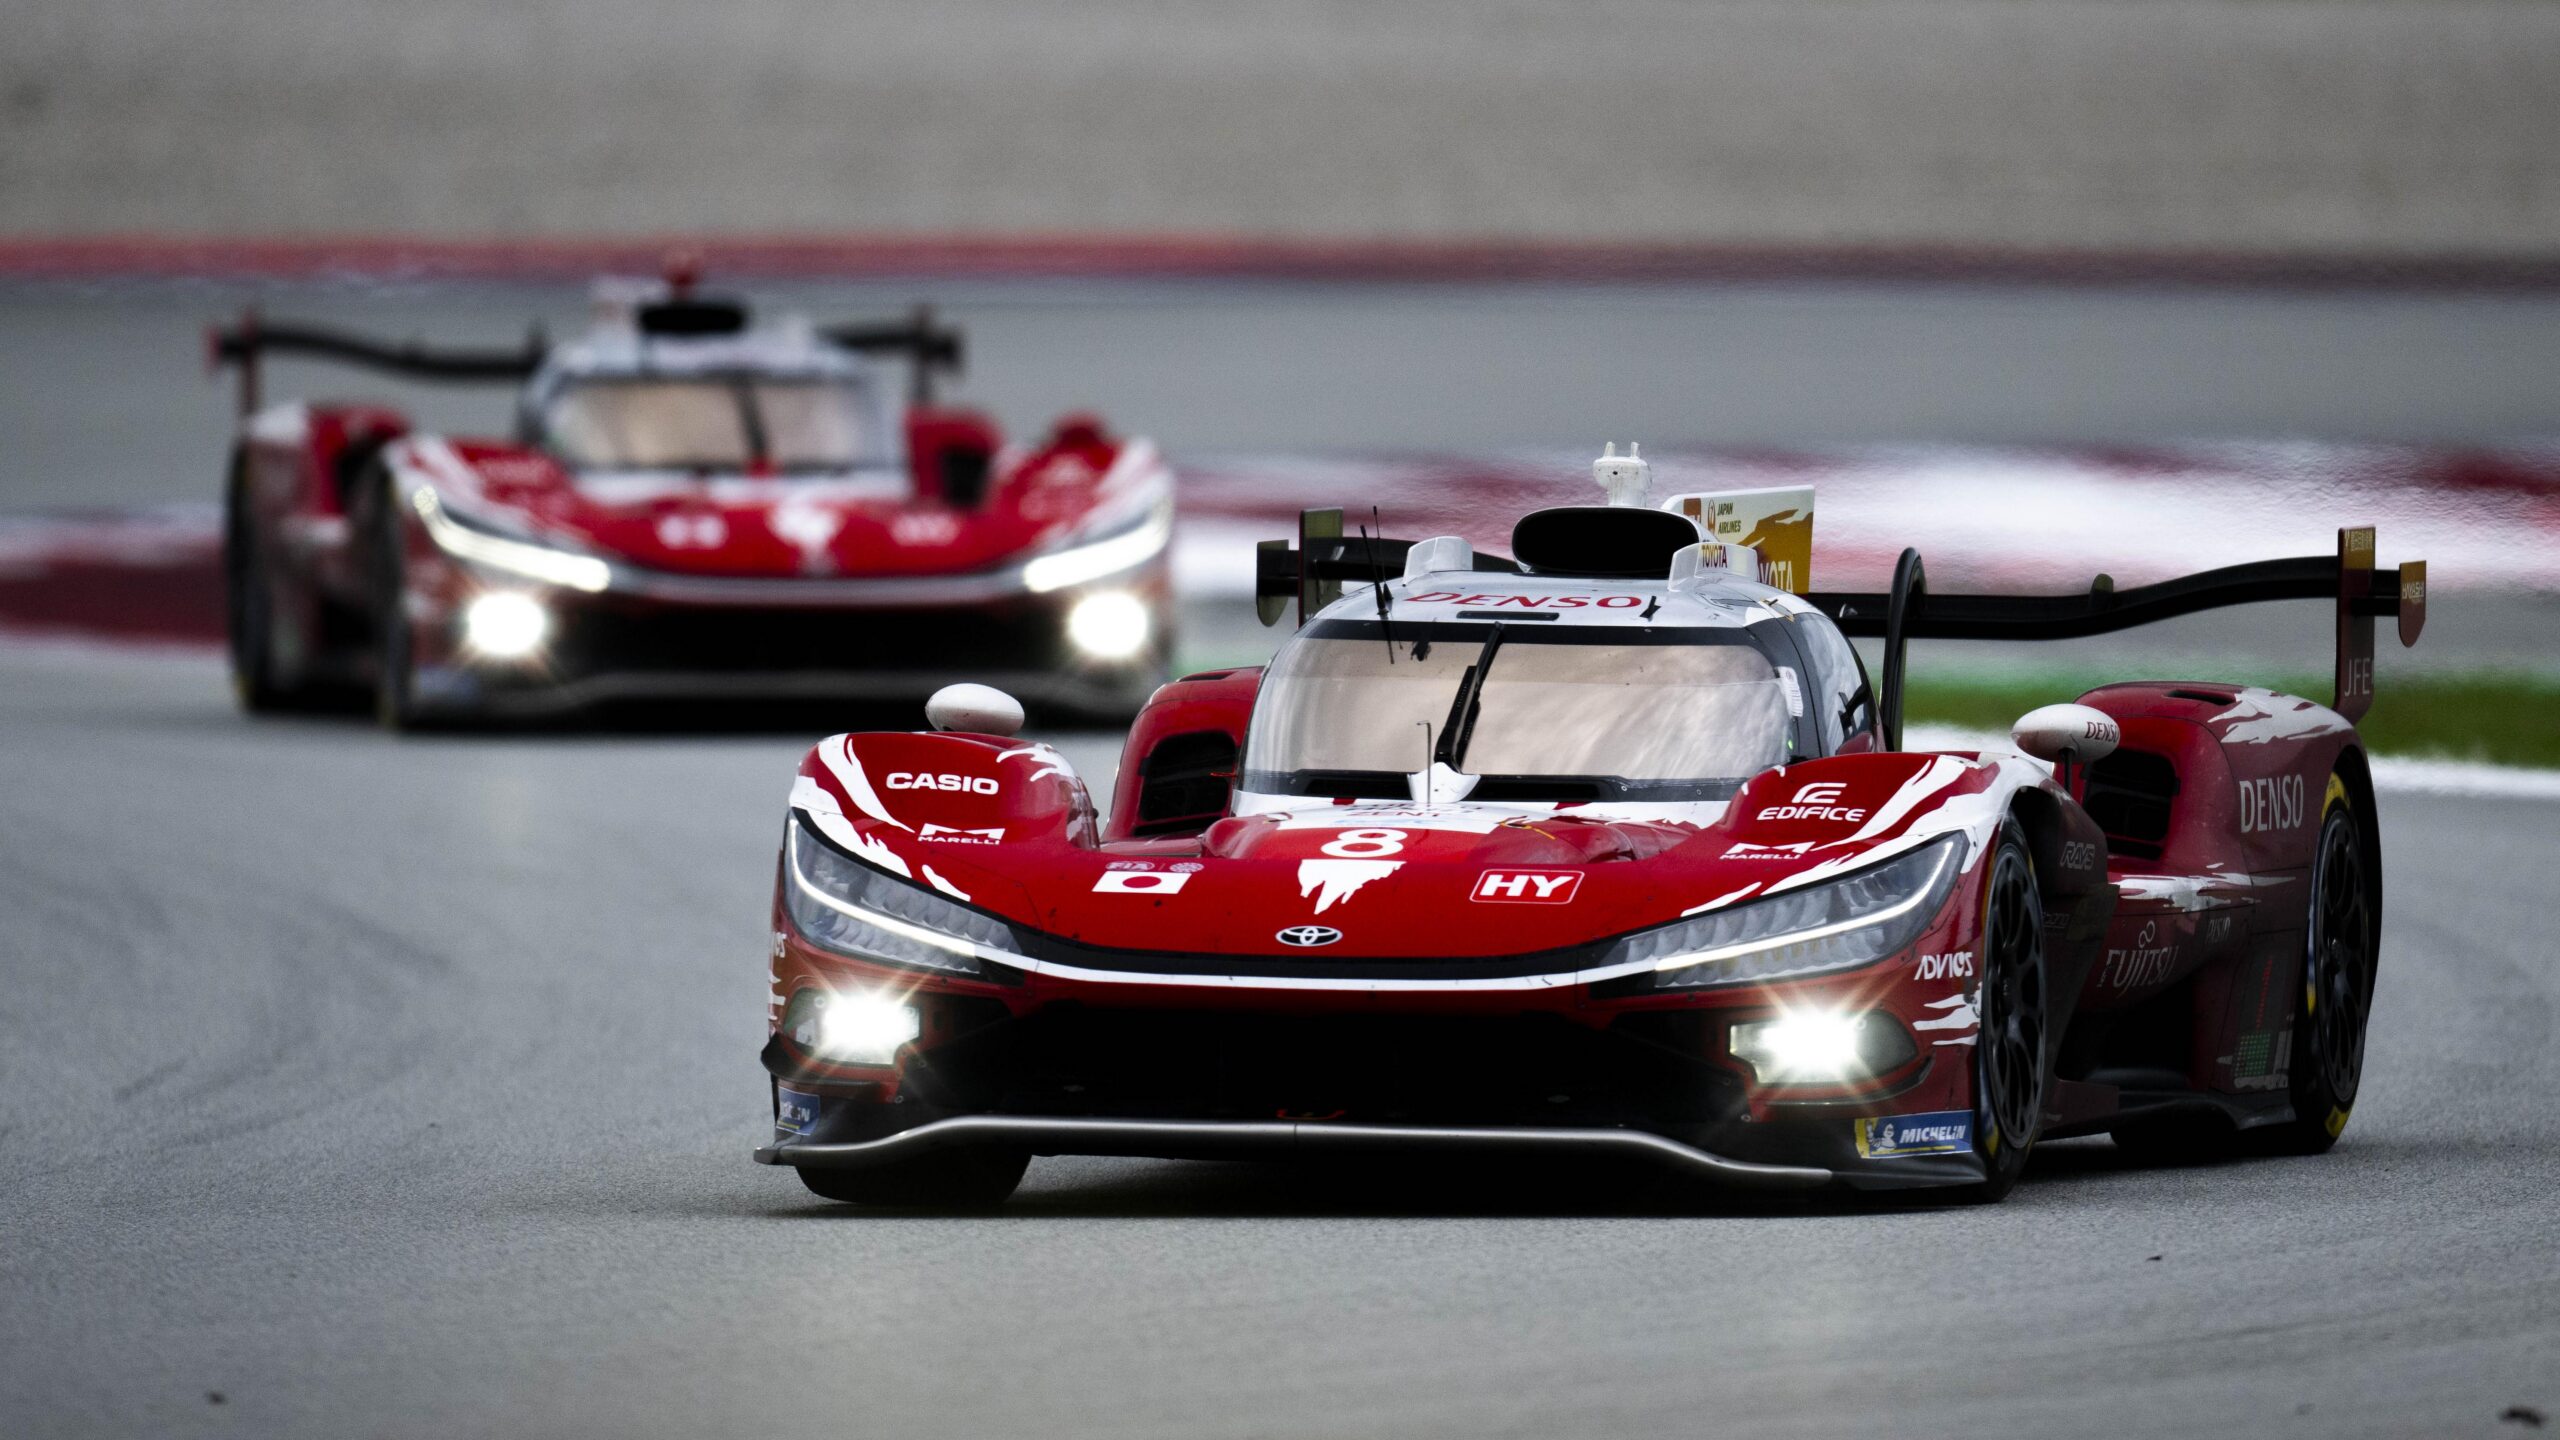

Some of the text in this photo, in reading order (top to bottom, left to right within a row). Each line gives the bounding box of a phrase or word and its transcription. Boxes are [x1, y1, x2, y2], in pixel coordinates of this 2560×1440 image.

[1717, 502, 1733, 516] JAPAN
[1718, 520, 1741, 534] AIRLINES
[1701, 545, 1728, 568] TOYOTA
[1757, 560, 1794, 594] YOTA
[1407, 592, 1642, 608] DENSO
[886, 772, 999, 795] CASIO
[1757, 806, 1866, 822] EDIFICE
[2239, 773, 2304, 833] DENSO
[918, 836, 1000, 844] MARELLI
[1320, 829, 1408, 857] 8
[2059, 841, 2096, 871] RAYS
[1479, 874, 1574, 898] HY
[1914, 951, 1974, 981] ADVICS
[2096, 945, 2180, 999] FUJITSU
[1899, 1124, 1966, 1144] MICHELIN
